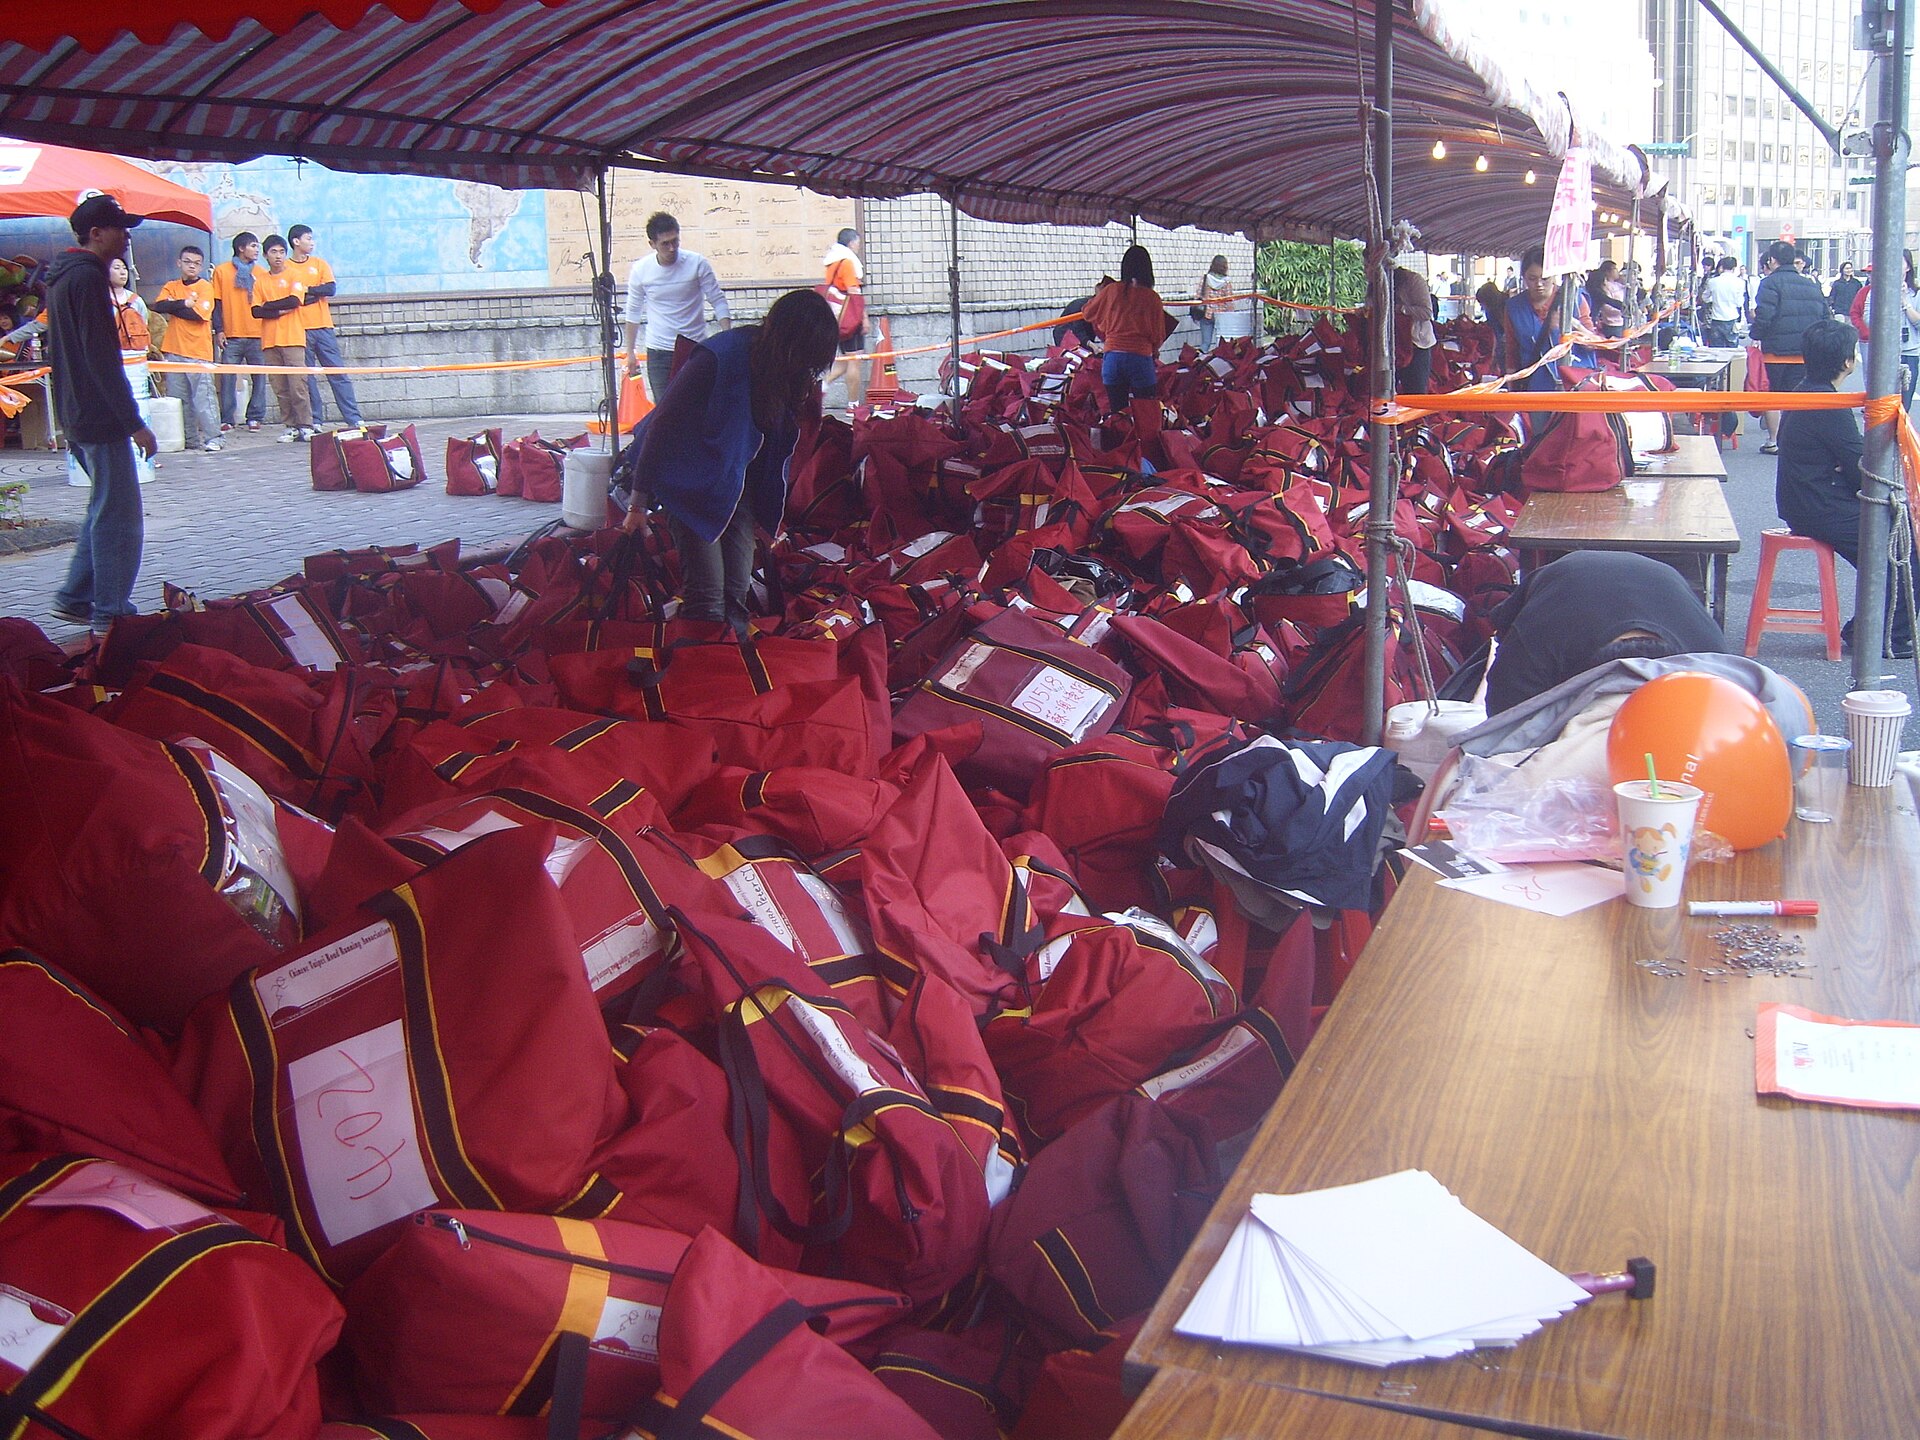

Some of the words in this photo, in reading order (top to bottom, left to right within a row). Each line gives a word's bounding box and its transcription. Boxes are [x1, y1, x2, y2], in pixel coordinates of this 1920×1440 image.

[288, 966, 310, 979] Chinese
[308, 956, 326, 970] Taipei
[325, 949, 340, 962] Road
[338, 940, 362, 955] Running
[361, 926, 391, 946] Association
